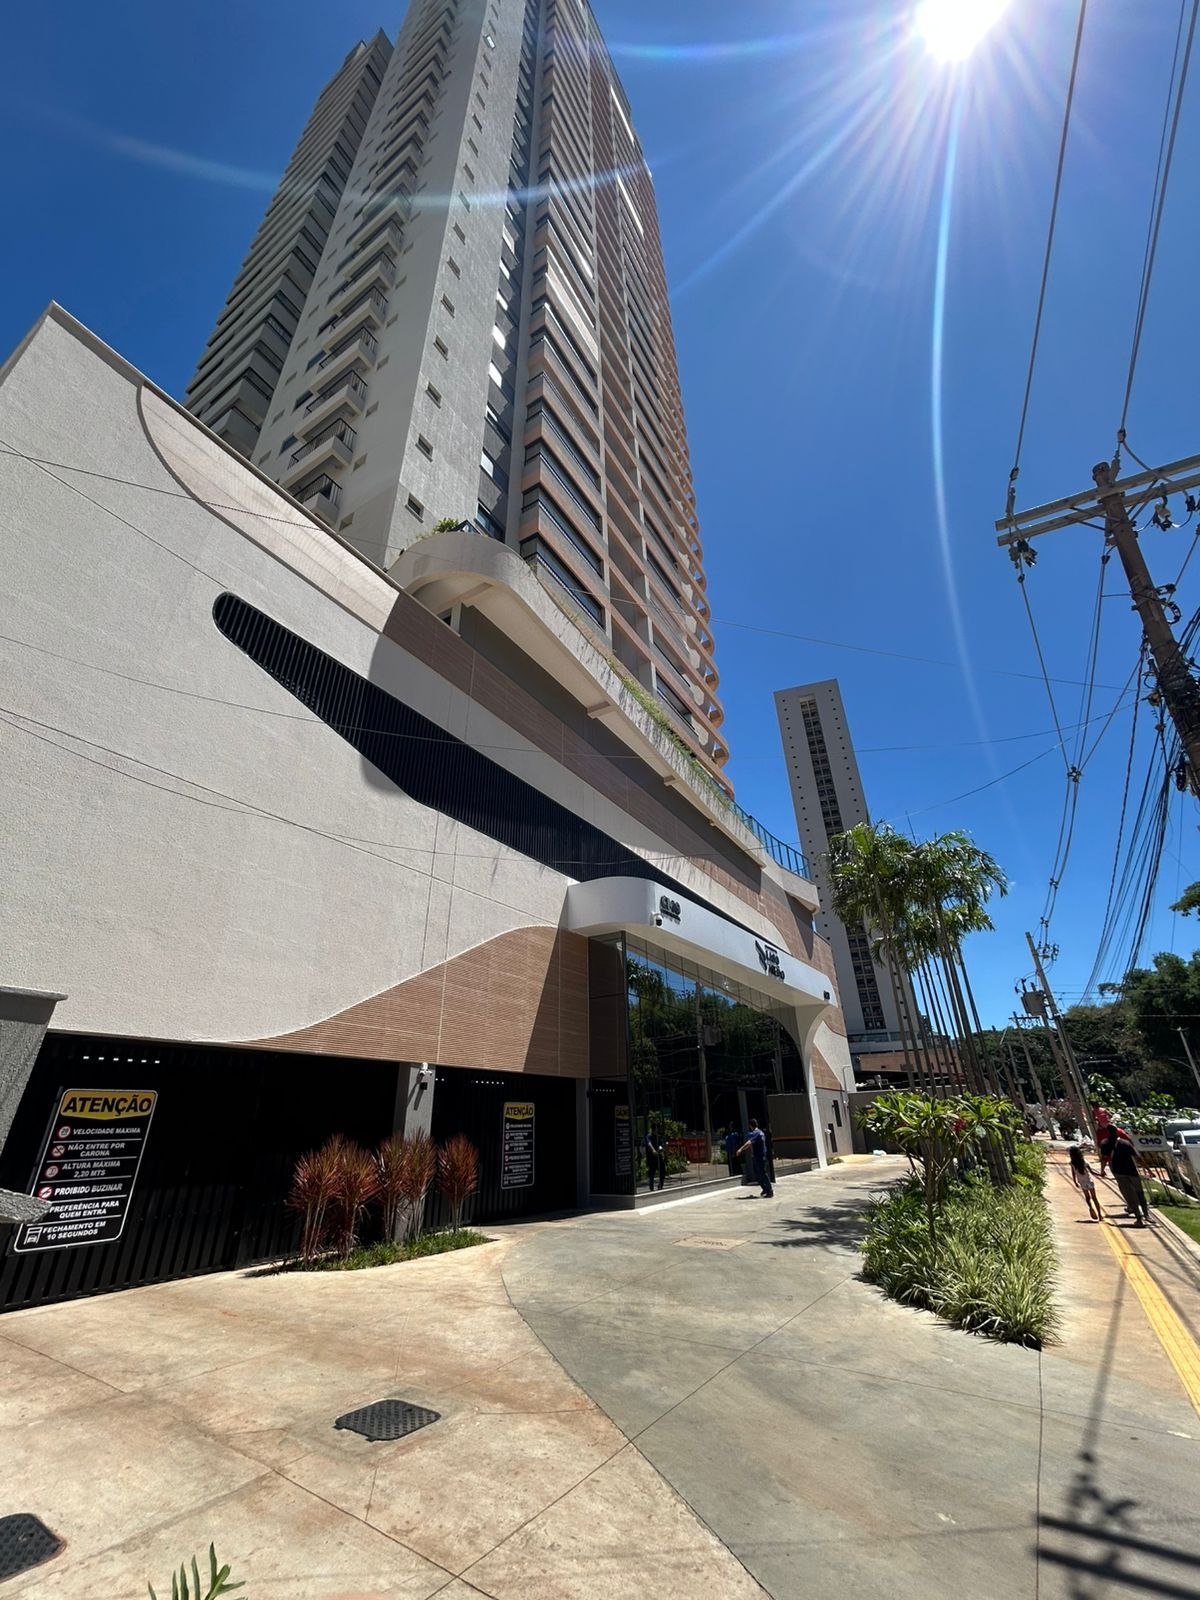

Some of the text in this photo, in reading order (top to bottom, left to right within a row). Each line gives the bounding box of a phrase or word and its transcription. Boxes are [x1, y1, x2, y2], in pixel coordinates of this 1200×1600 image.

[63, 1094, 152, 1117] ATENÇÃO
[85, 1142, 110, 1151] ENTRE
[80, 1149, 110, 1158] CARONA
[62, 1162, 91, 1170] ALTURA
[73, 1169, 106, 1179] 2,20 MTS
[54, 1183, 123, 1196] PROIBIDO BUZINAR
[49, 1200, 120, 1213] PREFERÊNCIA PARA
[59, 1208, 107, 1219] QUEM ENTRA
[42, 1220, 107, 1234] FECHAMENTO EM
[47, 1228, 98, 1240] 10 SEGUNDOS
